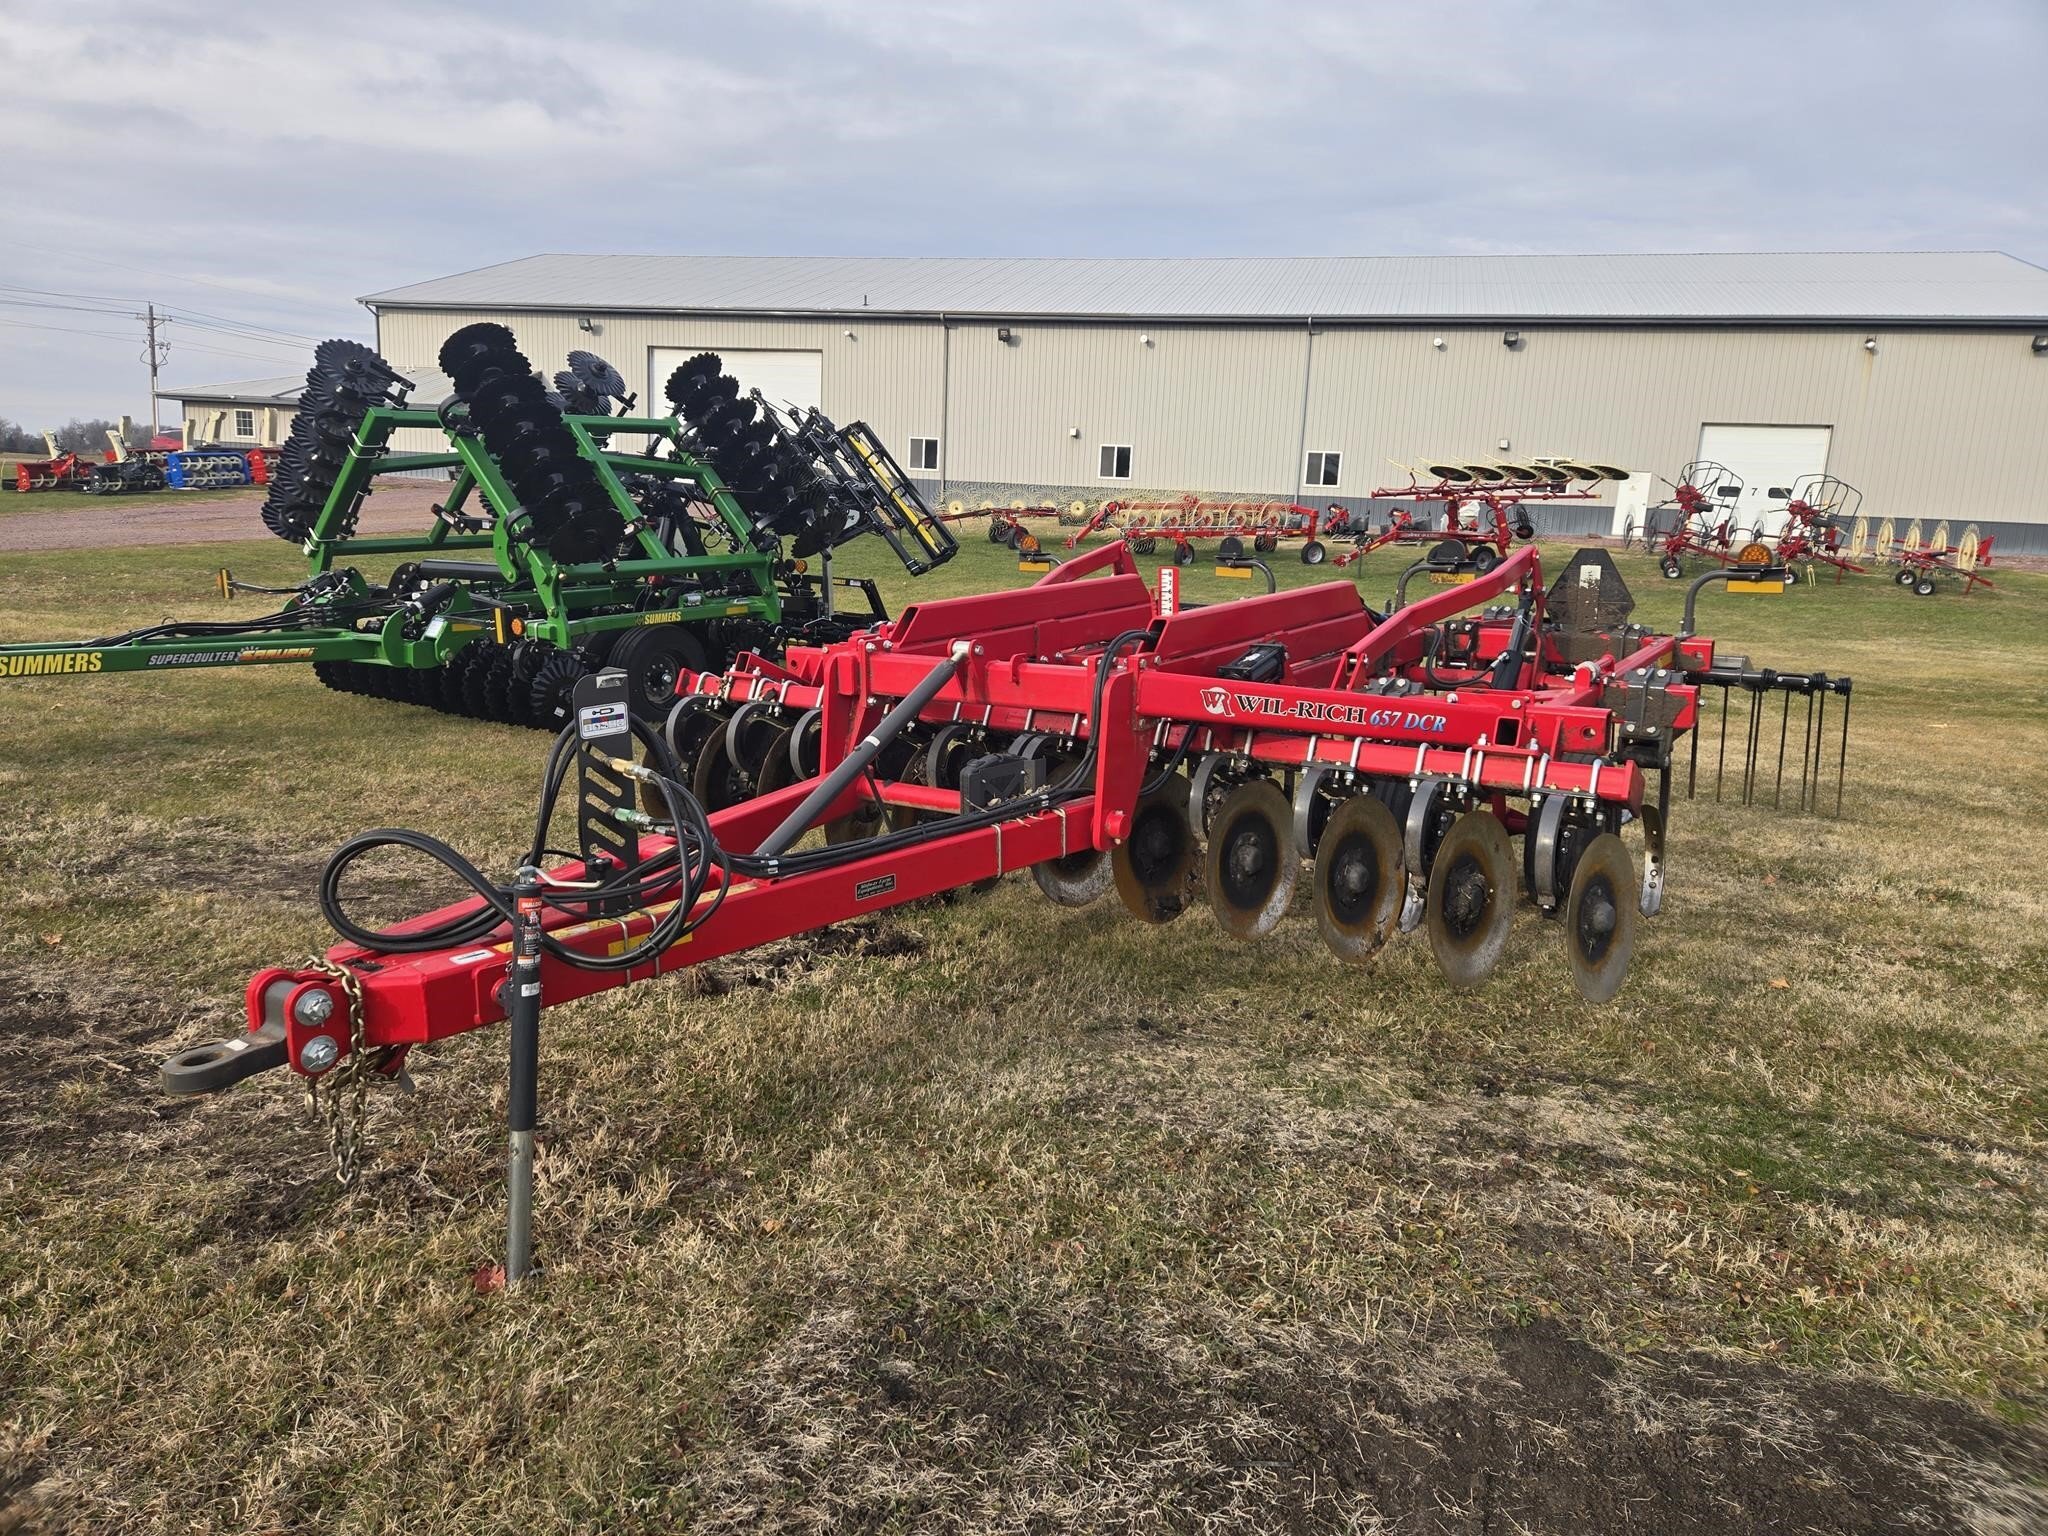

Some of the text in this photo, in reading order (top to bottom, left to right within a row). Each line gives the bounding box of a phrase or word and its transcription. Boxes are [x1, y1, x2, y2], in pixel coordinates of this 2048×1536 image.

[1751, 487, 1758, 496] 7
[645, 611, 682, 625] SUMMERS
[0, 652, 102, 677] SUMMERS
[148, 651, 236, 666] SUPERCOULTER
[1235, 694, 1447, 732] WIL-RICH 657 DCR
